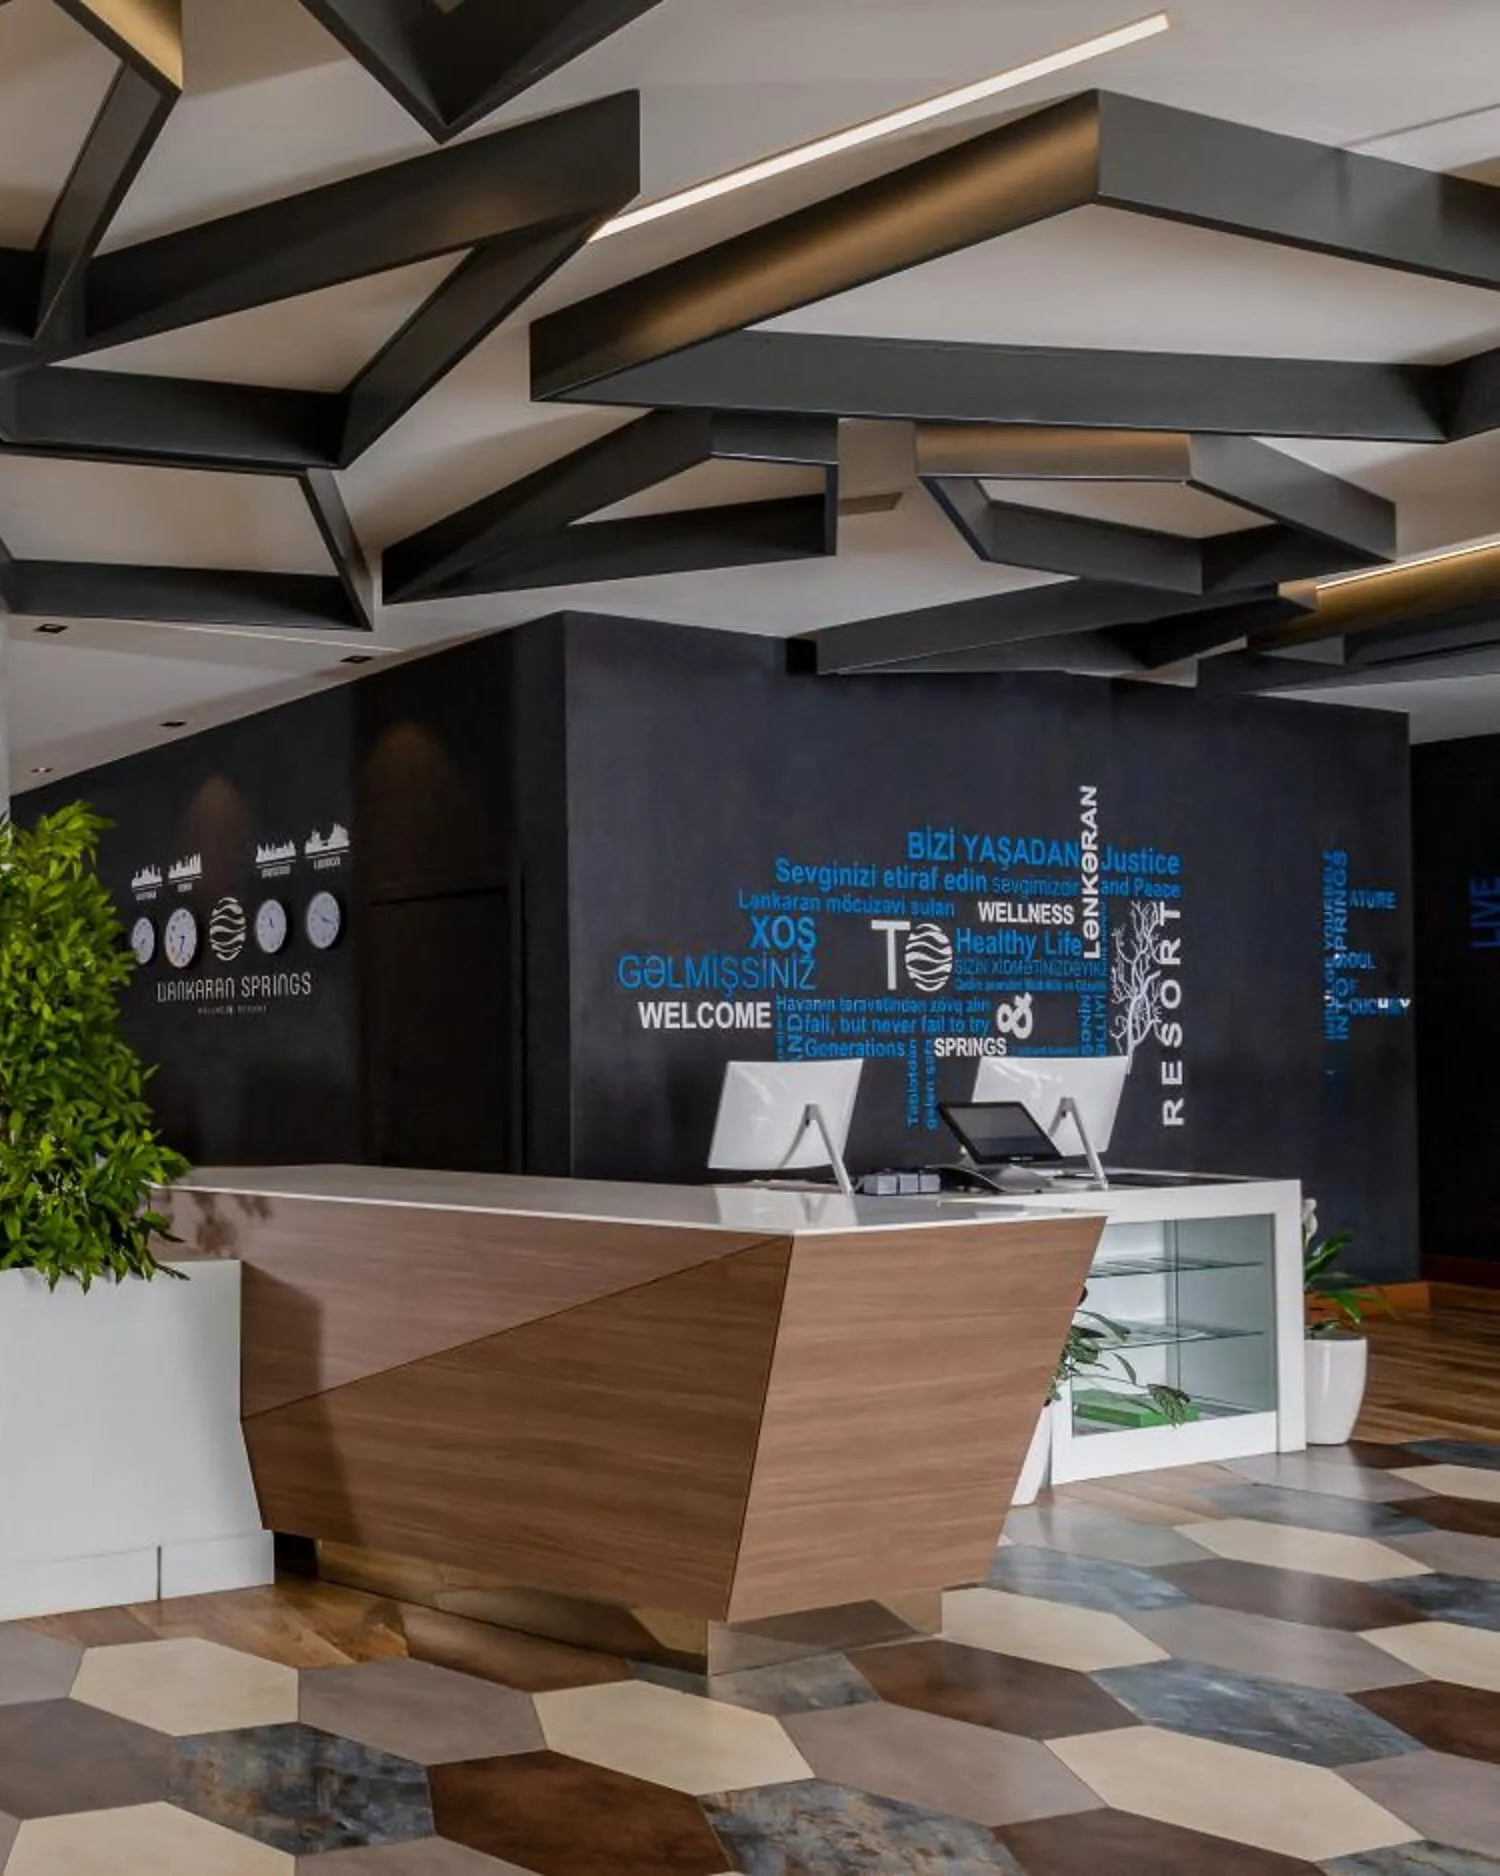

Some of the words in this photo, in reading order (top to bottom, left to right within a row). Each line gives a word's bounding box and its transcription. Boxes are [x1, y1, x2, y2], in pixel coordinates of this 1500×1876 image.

[962, 834, 1080, 870] YAŞADAN
[1100, 847, 1181, 876] Justice
[774, 856, 877, 892] Sevginizi
[883, 865, 939, 890] etiraf
[943, 867, 988, 893] edin
[1100, 877, 1129, 896] and
[1133, 878, 1182, 899] Peace
[977, 900, 1075, 925] WELLNESS
[750, 915, 817, 959] XOŞ
[955, 927, 1037, 959] Healthy
[1043, 929, 1083, 957] Life
[240, 972, 312, 998] SPRINGS
[637, 1001, 773, 1029] WELCOME
[840, 1015, 867, 1033] but
[871, 1018, 917, 1034] never
[948, 1017, 966, 1034] to
[968, 1016, 989, 1037] try
[996, 991, 1033, 1040] &
[1158, 900, 1185, 1127] RESORT
[804, 1038, 905, 1057] Generations
[933, 1037, 1007, 1058] SPRINGS
